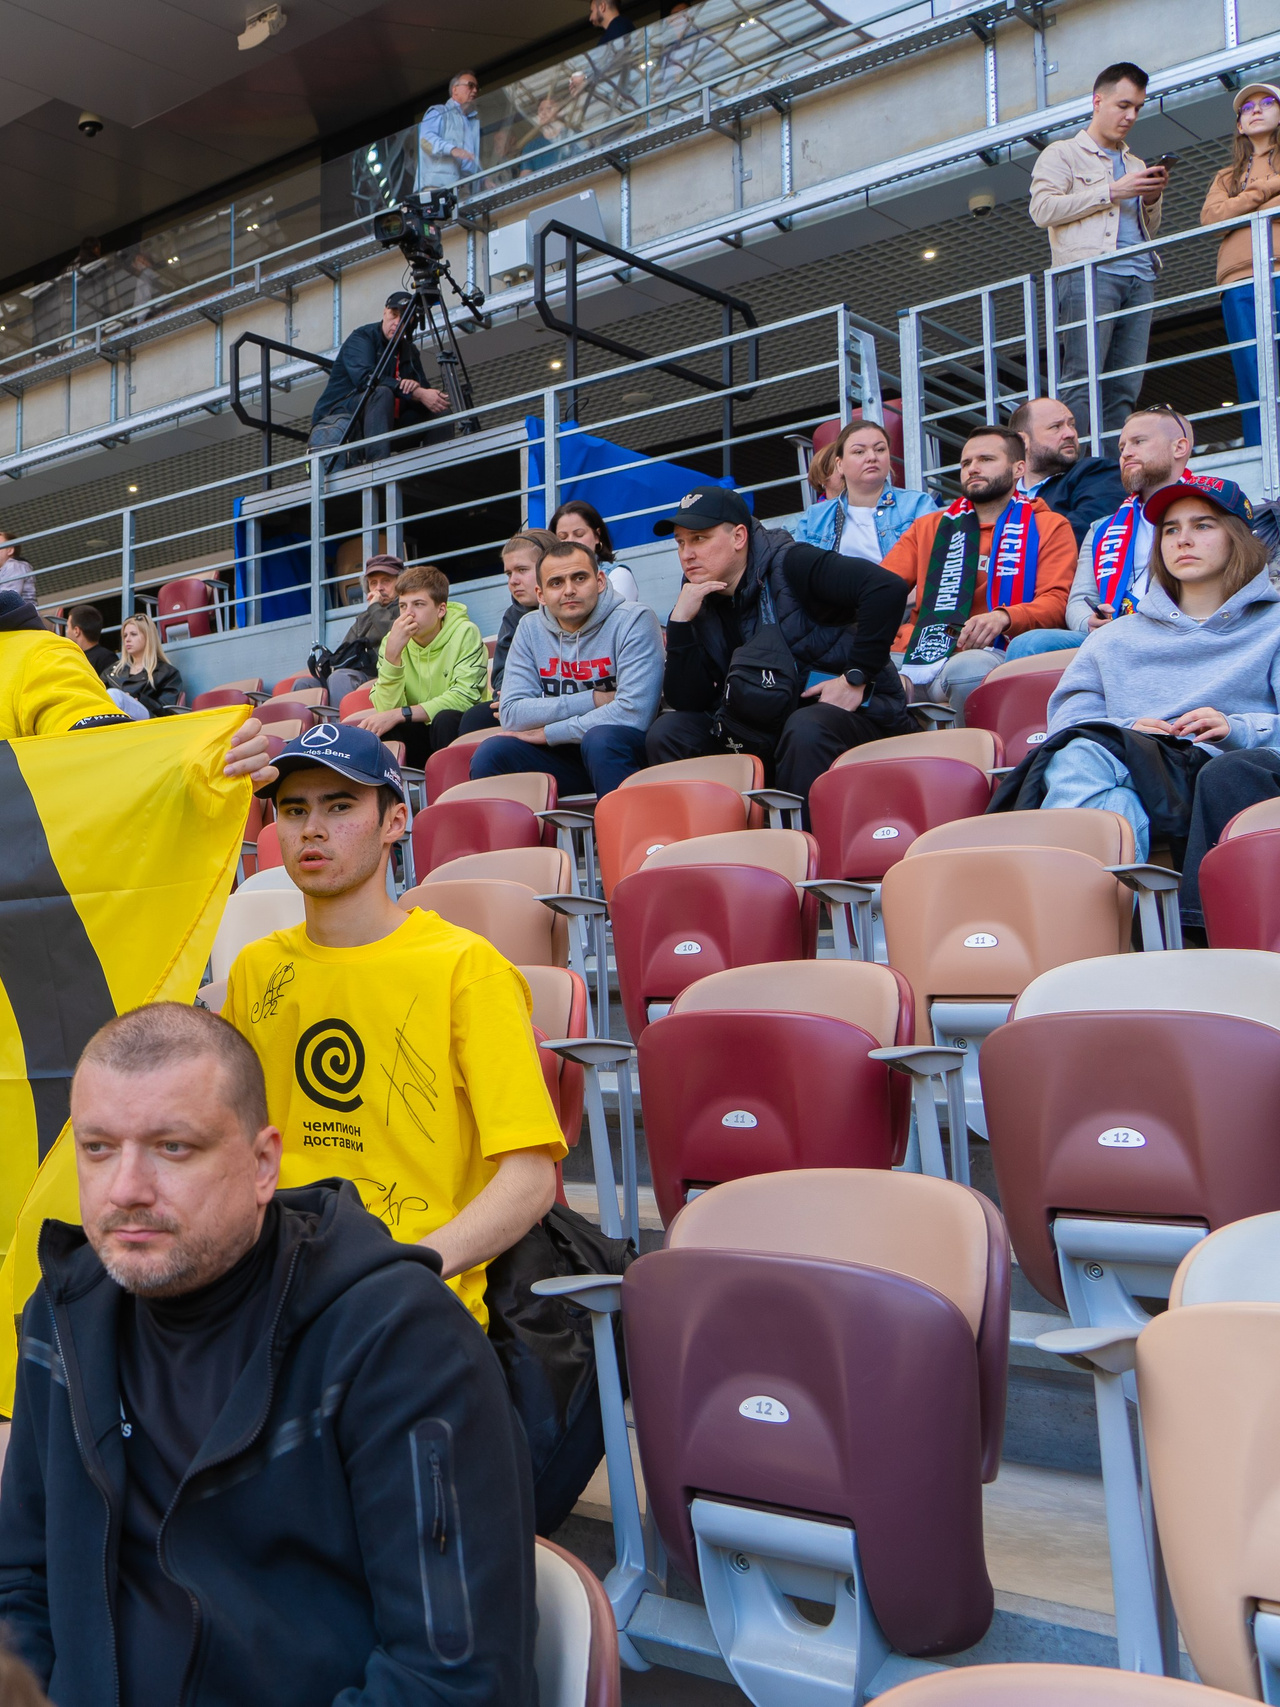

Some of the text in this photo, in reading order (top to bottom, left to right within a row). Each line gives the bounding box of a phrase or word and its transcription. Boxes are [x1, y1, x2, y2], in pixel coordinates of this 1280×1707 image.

[996, 523, 1024, 577] ЦСКА
[1097, 525, 1128, 580] ЦСКА
[934, 531, 966, 611] КРАСНОДАР
[540, 657, 612, 680] JUST
[304, 749, 351, 759] des-Benz
[733, 1114, 745, 1123] 11
[303, 1121, 361, 1137] чемпион
[303, 1135, 364, 1152] доставки
[1114, 1132, 1129, 1143] 12
[756, 1401, 773, 1415] 12
